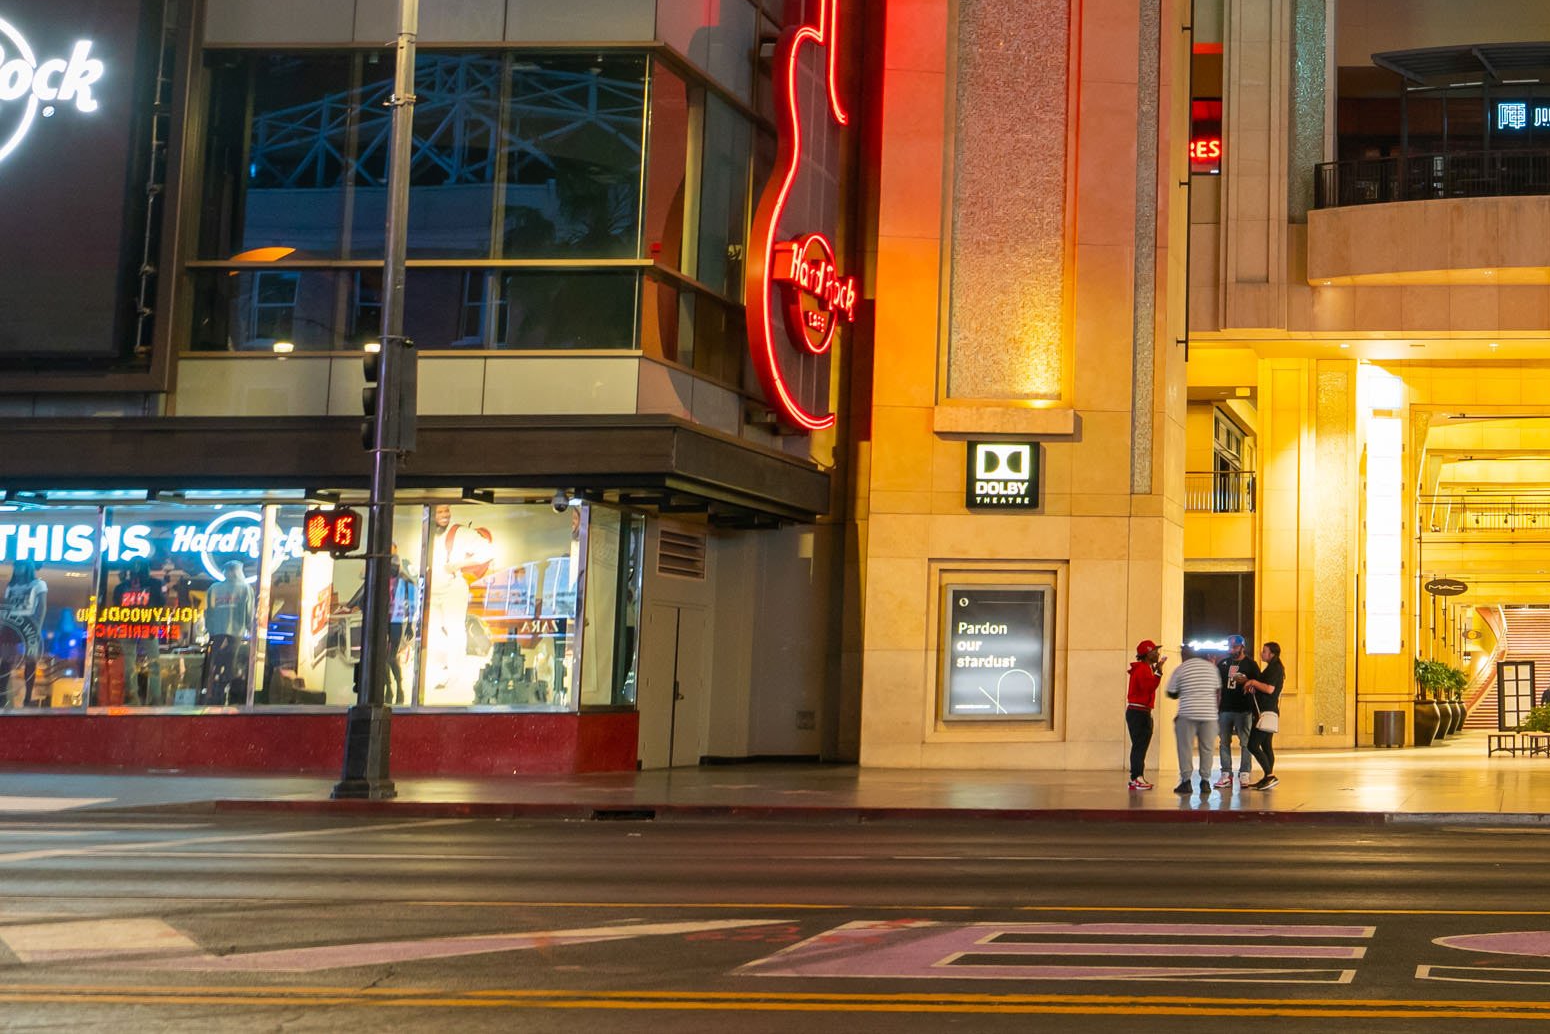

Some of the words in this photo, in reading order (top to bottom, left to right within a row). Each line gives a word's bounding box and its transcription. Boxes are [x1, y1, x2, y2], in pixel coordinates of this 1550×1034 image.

[0, 39, 104, 113] ock
[790, 243, 827, 294] Hard
[826, 265, 856, 321] Rock
[976, 481, 1029, 495] DOLBY
[0, 524, 94, 562] THIS
[171, 525, 241, 553] Hard
[240, 526, 304, 558] Rck
[958, 622, 1008, 635] Pardon
[956, 640, 983, 652] our
[956, 654, 1017, 668] stardust
